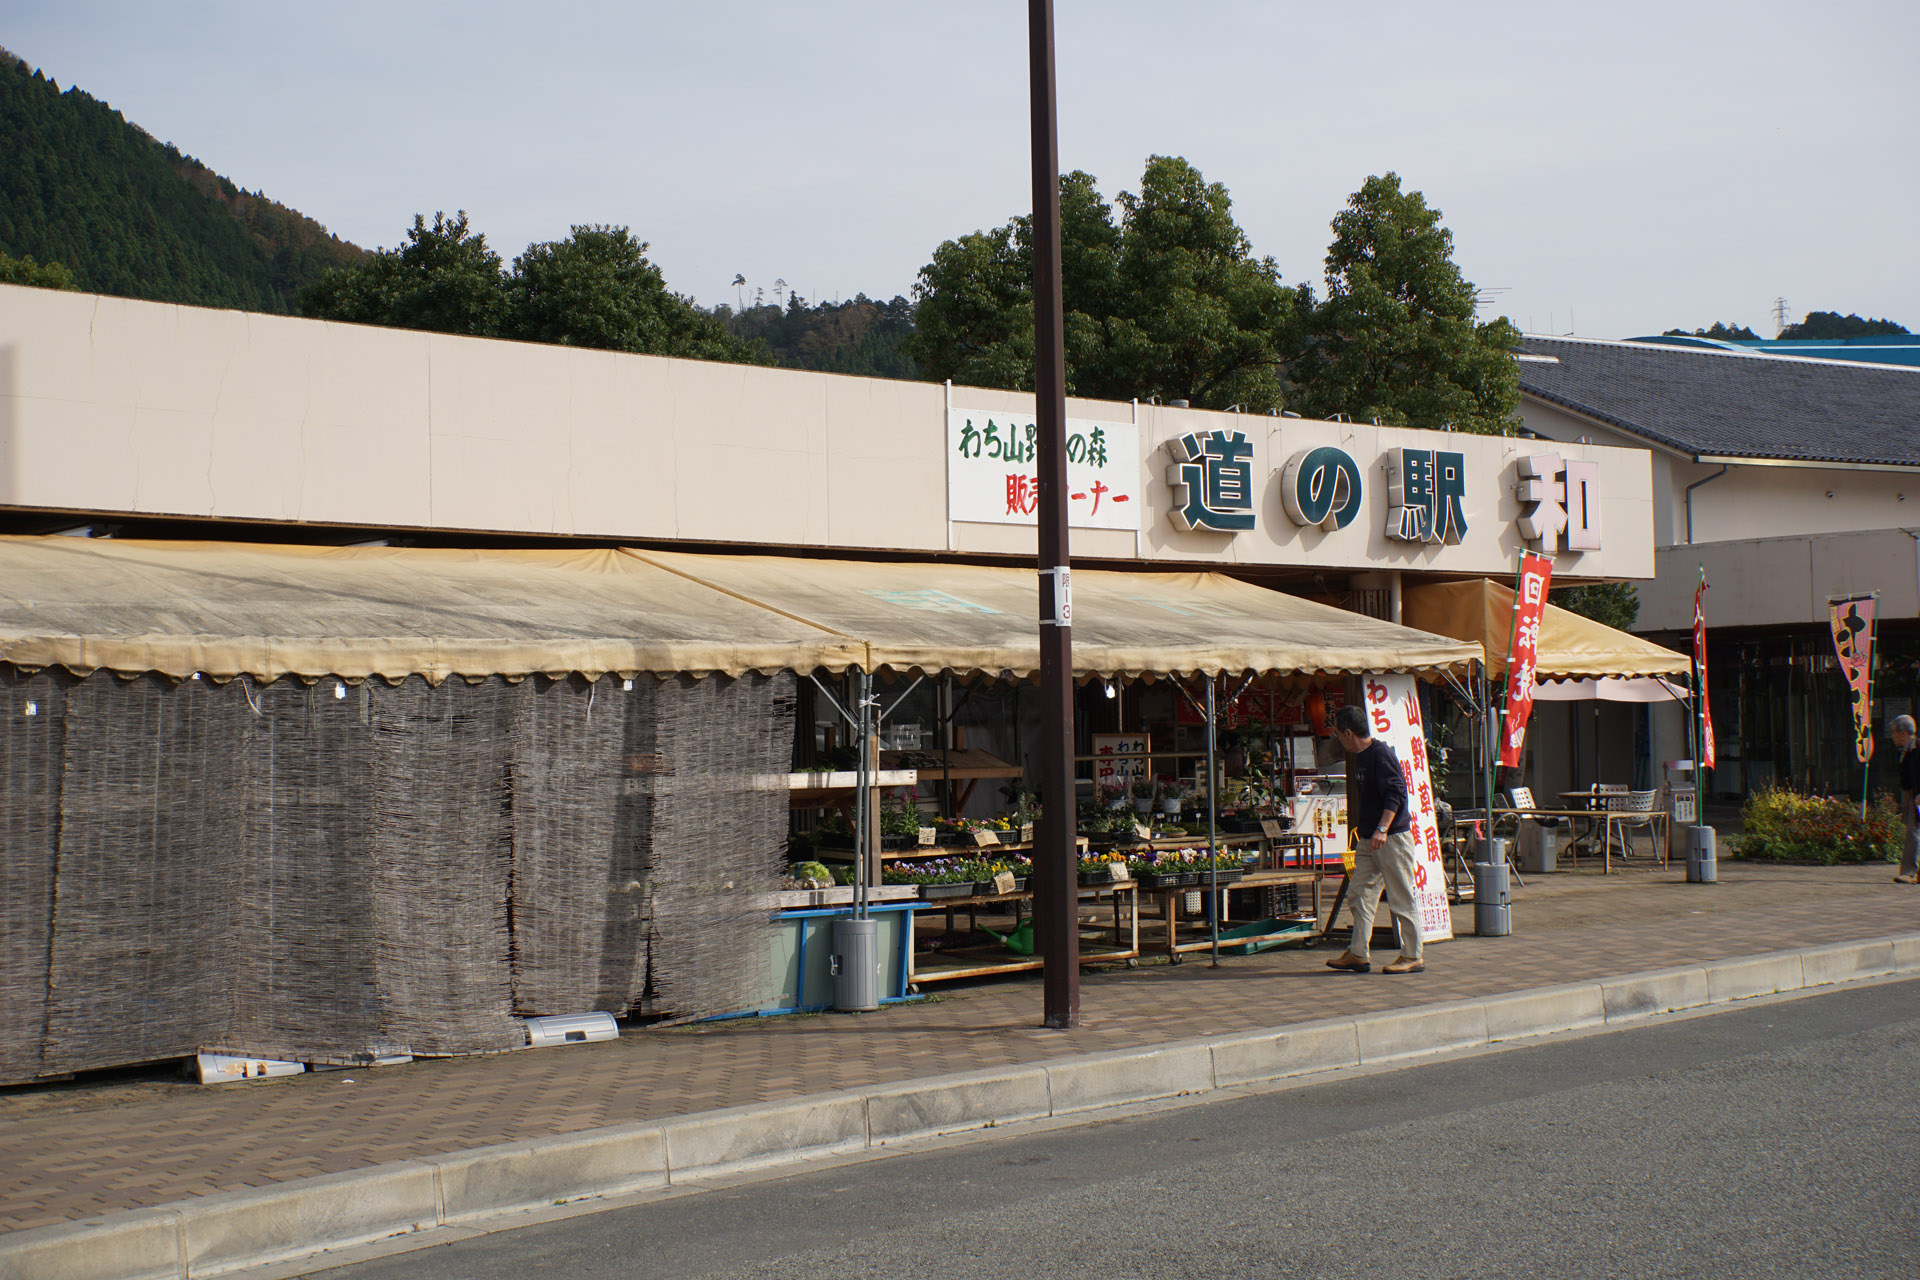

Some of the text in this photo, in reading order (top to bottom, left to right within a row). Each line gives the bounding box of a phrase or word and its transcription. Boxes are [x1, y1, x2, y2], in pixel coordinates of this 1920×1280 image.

[958, 418, 1108, 469] わち山野の森
[1005, 473, 1130, 517] 販ーナー
[1366, 679, 1391, 733] わち
